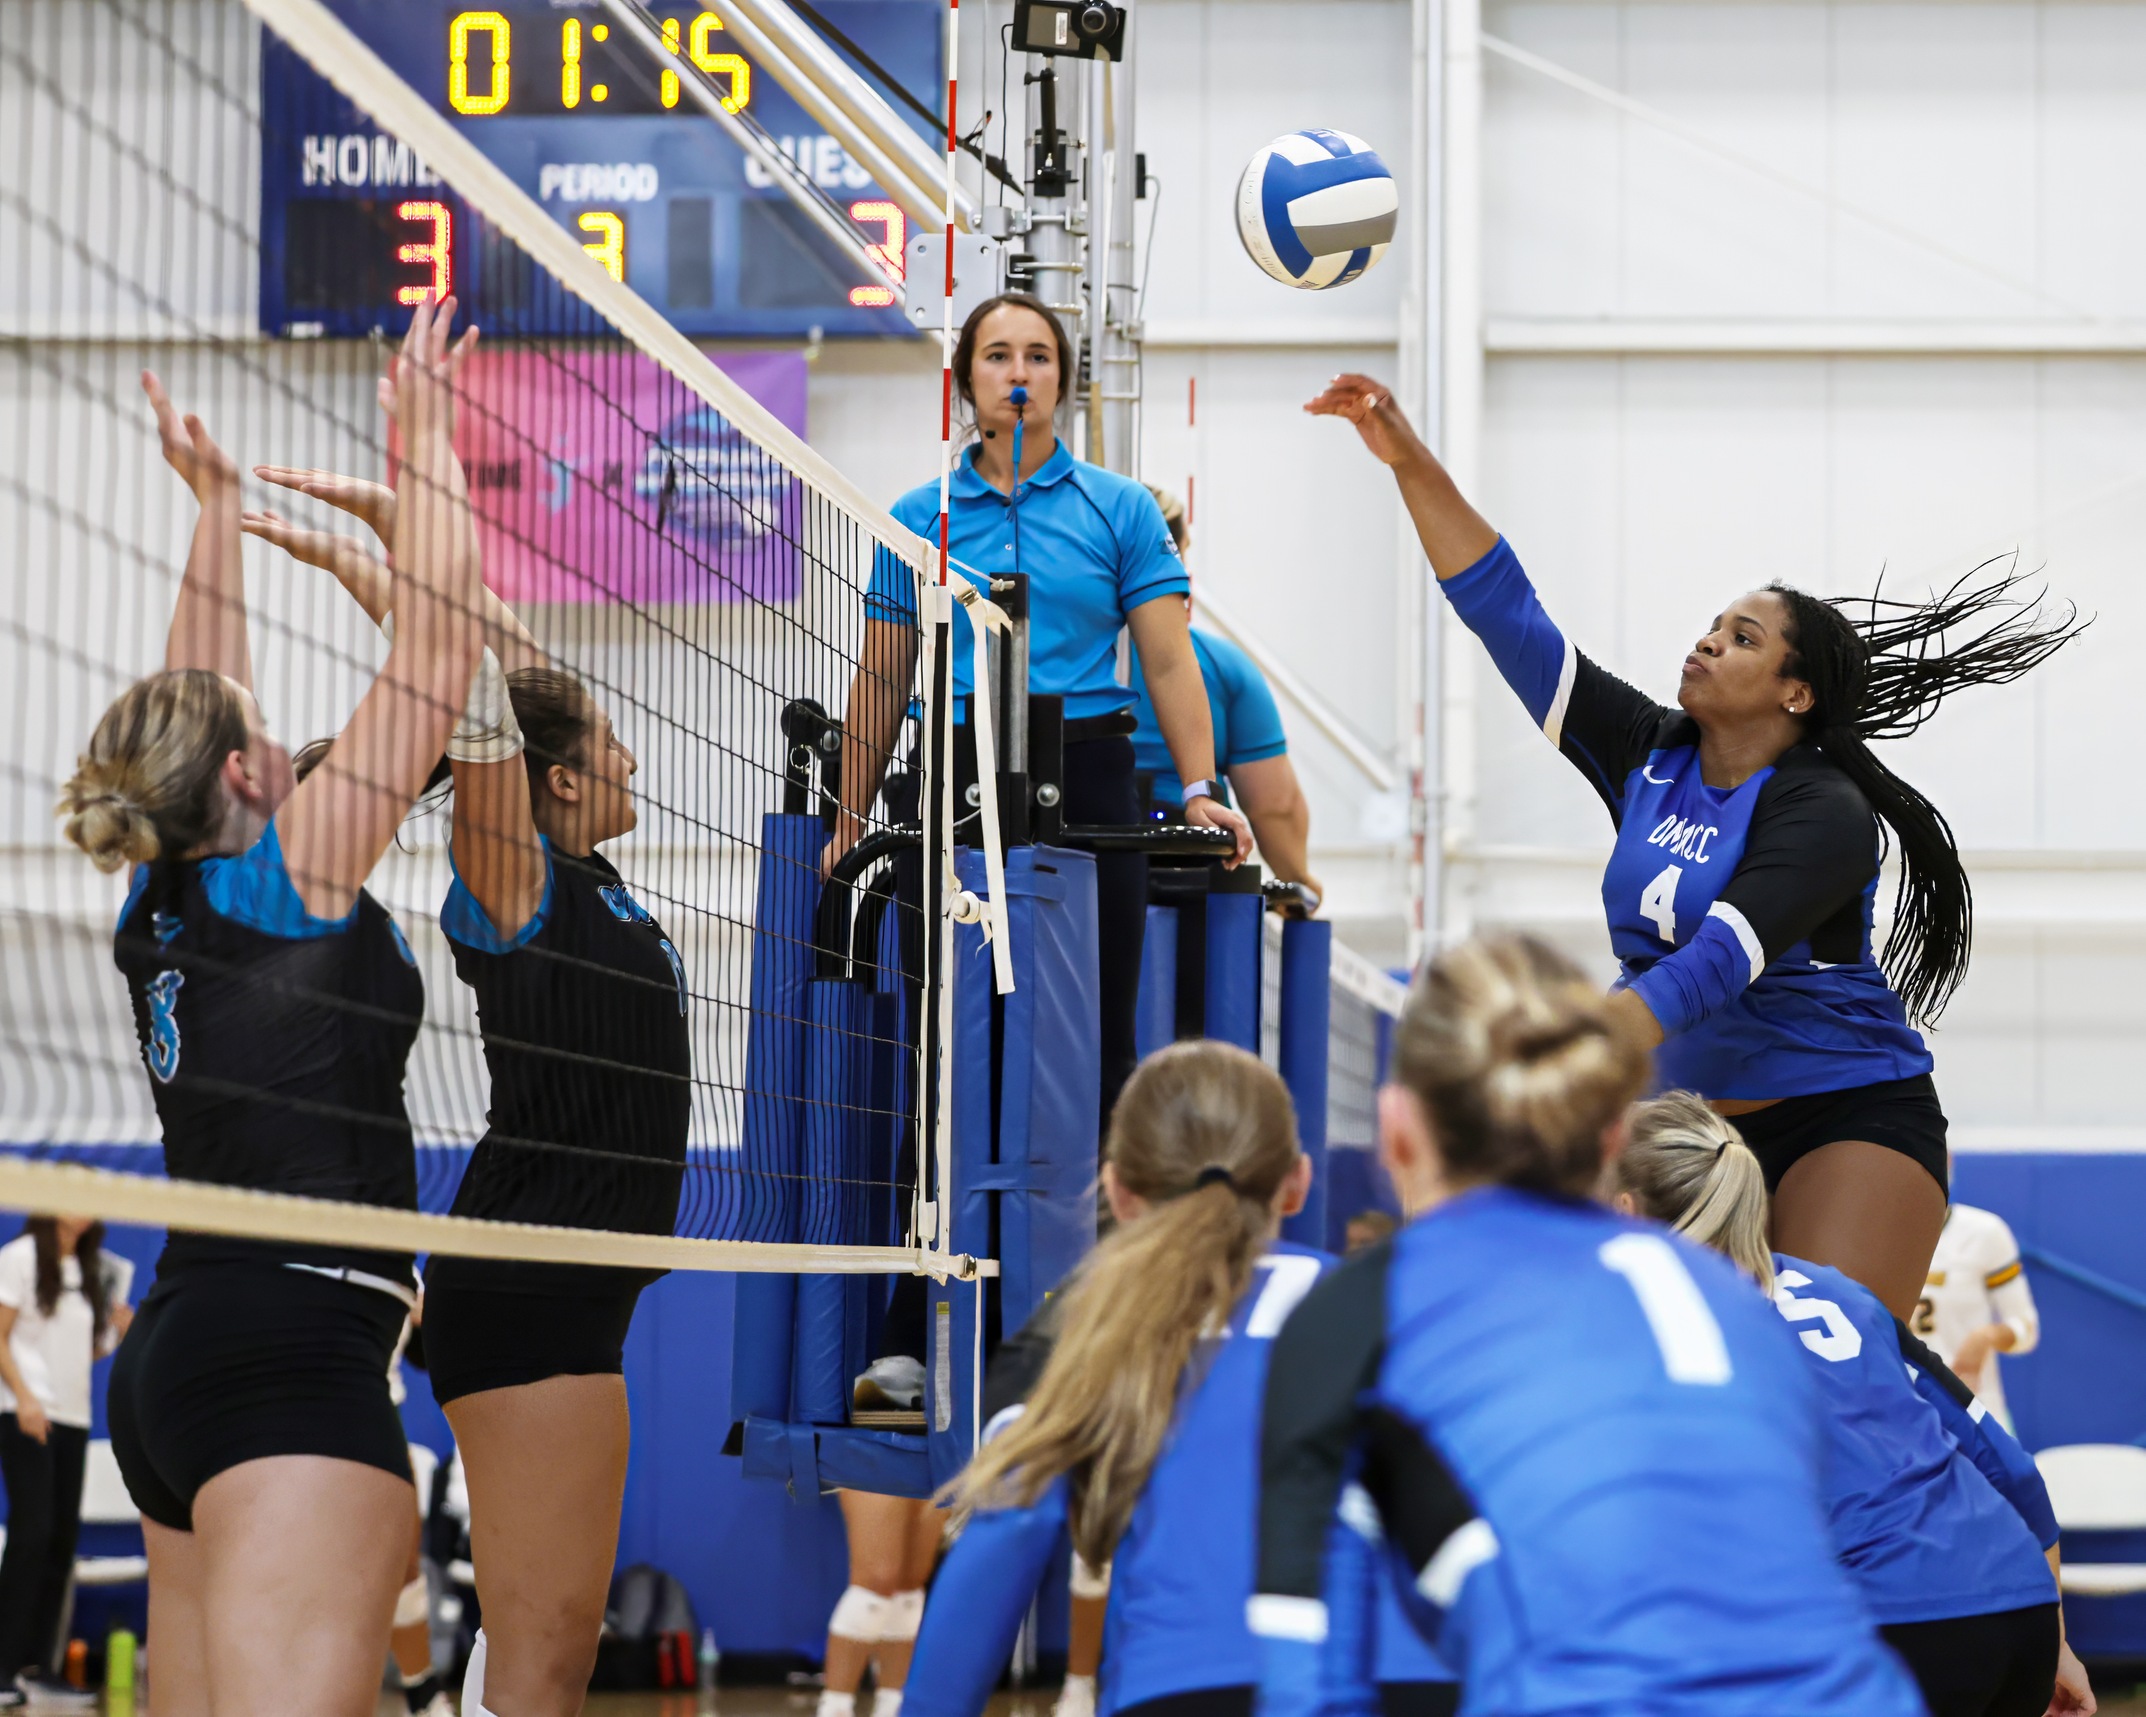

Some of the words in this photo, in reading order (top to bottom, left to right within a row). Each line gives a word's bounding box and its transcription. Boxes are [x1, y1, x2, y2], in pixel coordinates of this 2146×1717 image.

[449, 11, 750, 114] 01:15
[540, 163, 658, 201] PERIOD
[398, 201, 451, 304] 3
[1639, 863, 1683, 944] 4
[1598, 1232, 1733, 1386] 1
[1773, 1269, 1862, 1362] 5
